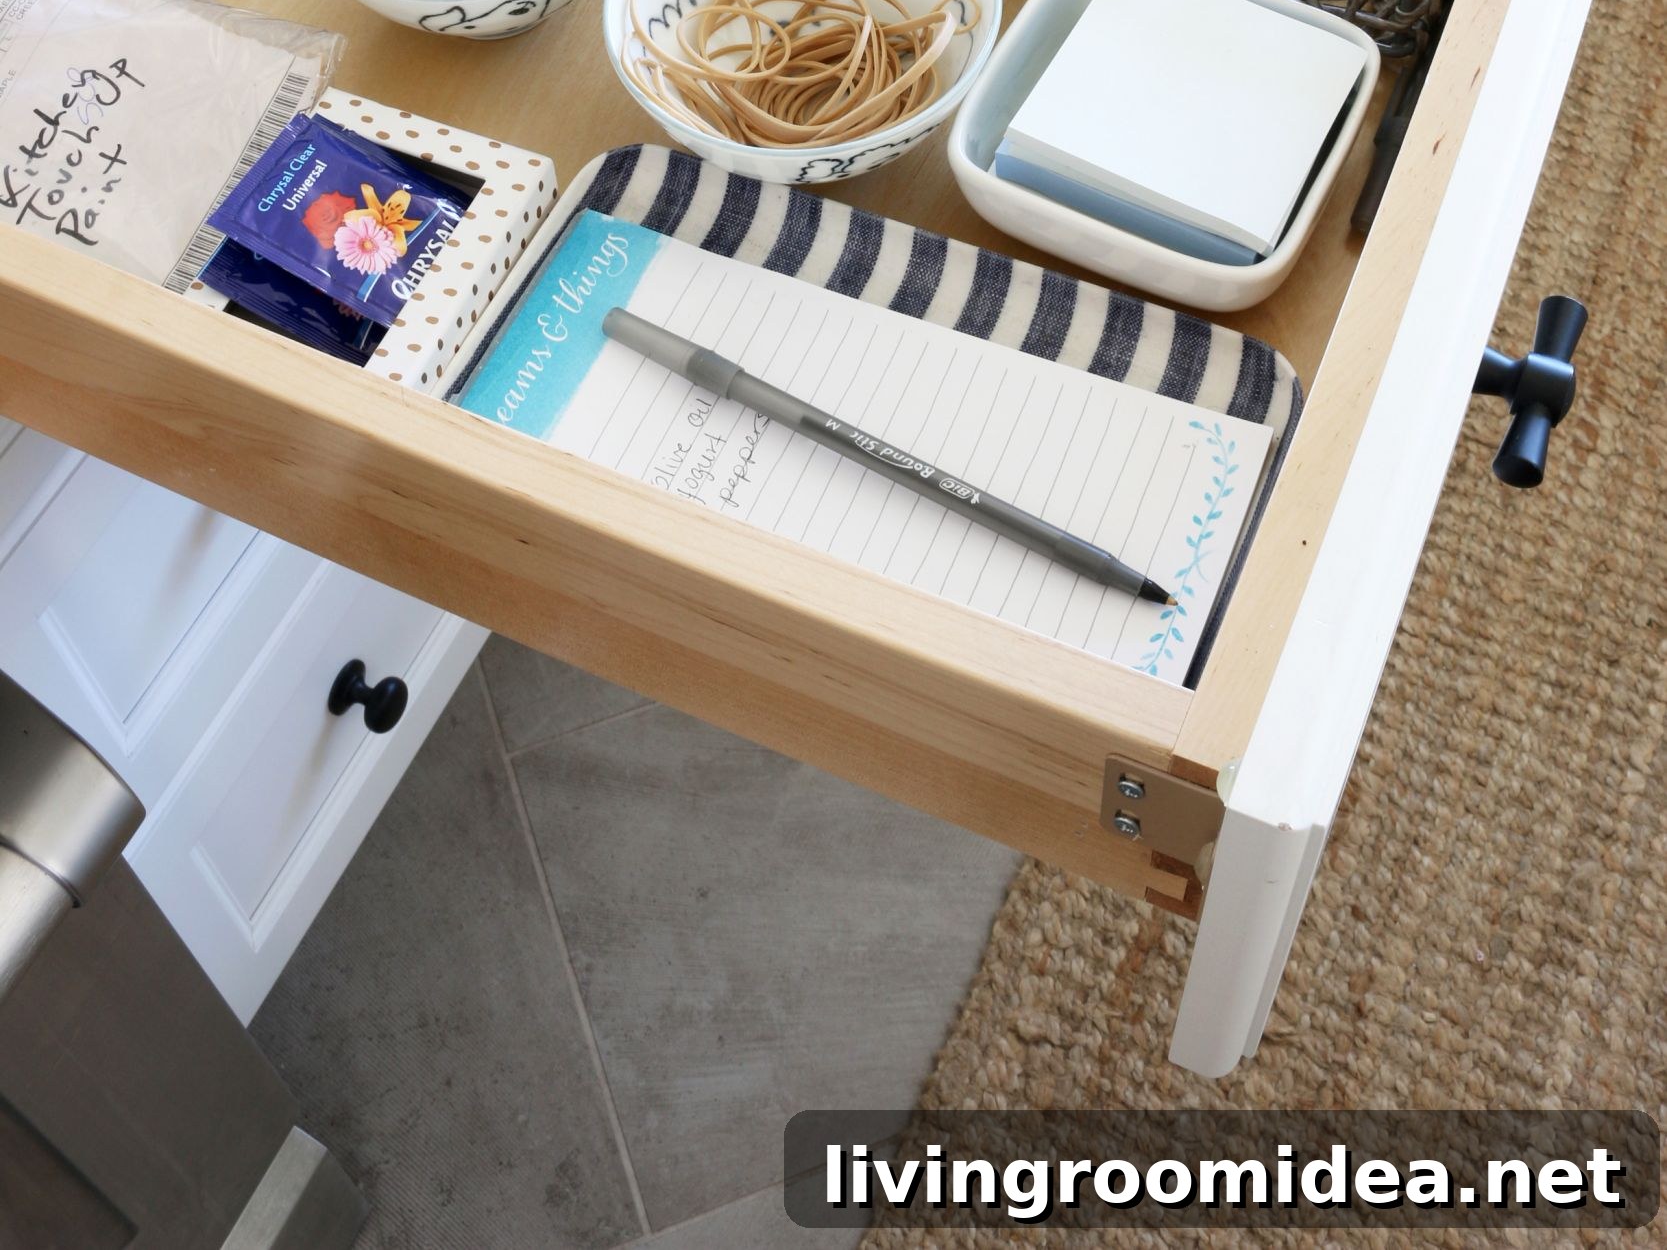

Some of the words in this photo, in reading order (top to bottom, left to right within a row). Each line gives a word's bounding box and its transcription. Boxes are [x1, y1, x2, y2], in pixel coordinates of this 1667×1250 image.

[16, 125, 100, 225] Touch
[55, 143, 128, 246] Paint
[258, 170, 294, 212] Chrysal
[289, 143, 317, 171] Clear
[282, 159, 328, 212] Universal
[552, 232, 629, 314] things
[537, 313, 568, 342] &
[825, 418, 841, 431] M
[849, 430, 880, 451] Stic
[879, 447, 936, 478] Round
